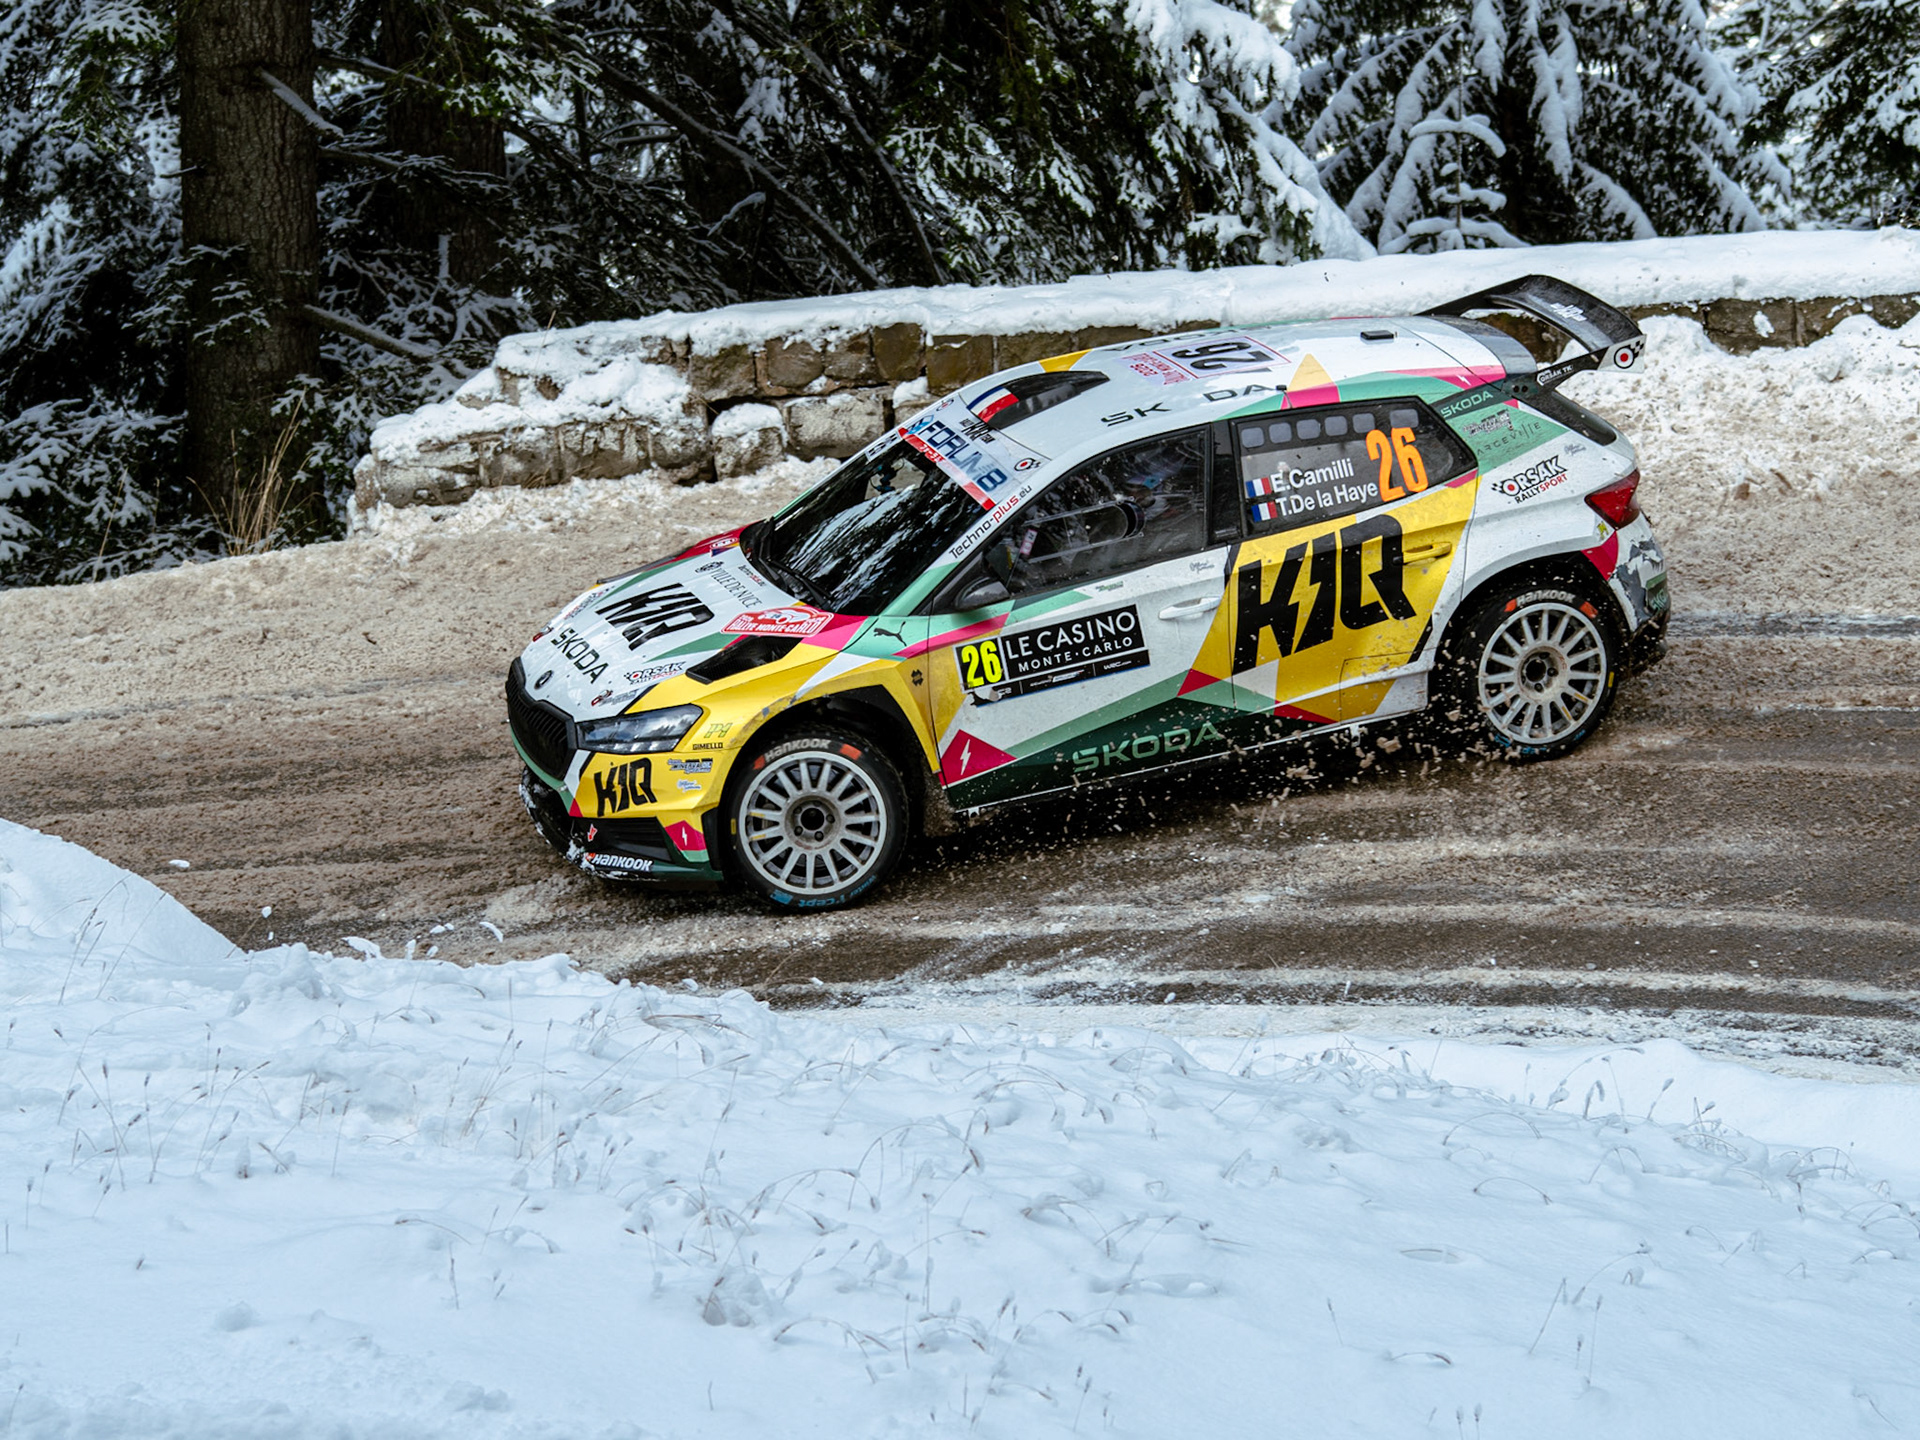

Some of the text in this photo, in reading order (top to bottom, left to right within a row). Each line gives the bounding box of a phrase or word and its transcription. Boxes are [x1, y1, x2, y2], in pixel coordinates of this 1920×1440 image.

[1440, 391, 1494, 418] SKODA
[1365, 427, 1429, 502] 26
[949, 485, 1033, 559] Techno-plus.eu
[1275, 482, 1379, 517] T.De la Haye
[551, 628, 610, 684] SKODA
[1005, 611, 1136, 660] LE CASINO
[961, 640, 1003, 689] 26
[1072, 721, 1223, 773] SKODA
